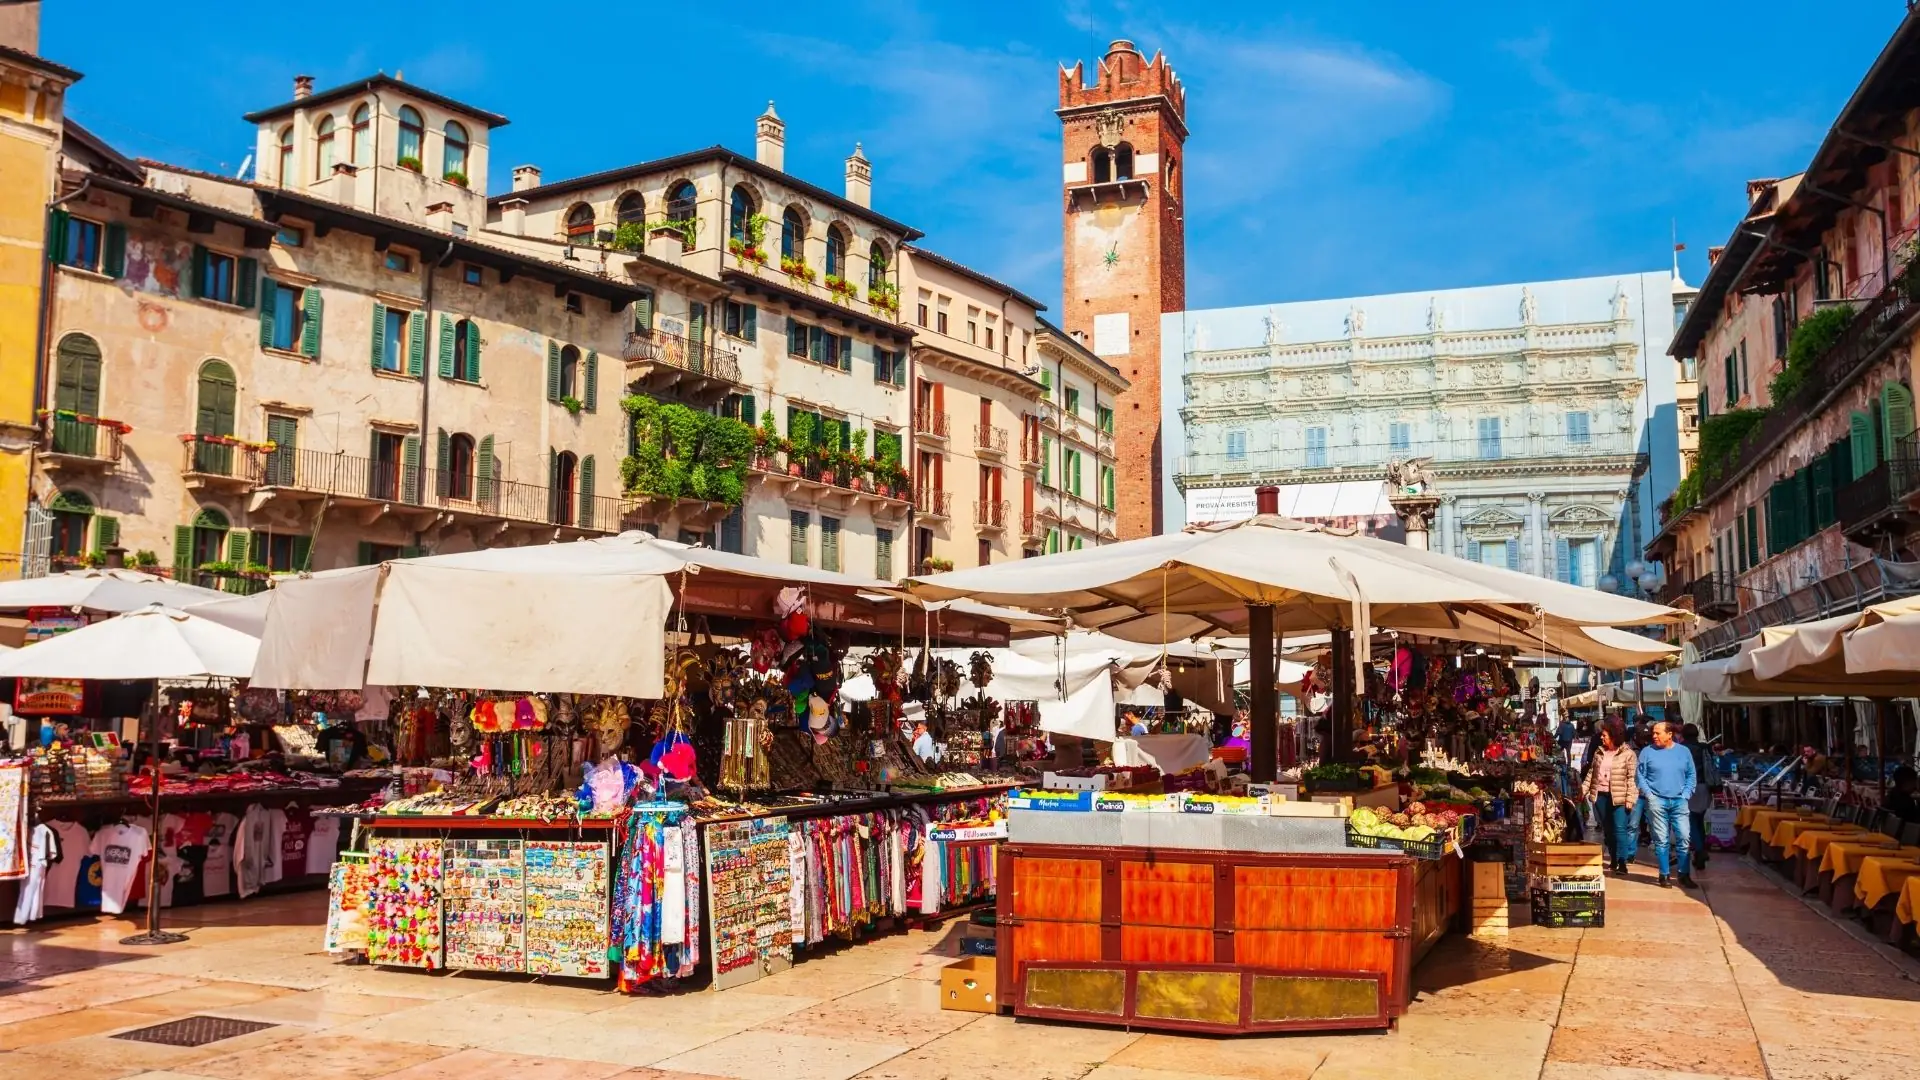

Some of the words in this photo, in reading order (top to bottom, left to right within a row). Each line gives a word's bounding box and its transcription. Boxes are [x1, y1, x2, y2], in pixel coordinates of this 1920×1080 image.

[1097, 802, 1124, 811] Melinda
[1185, 803, 1213, 812] Melinda
[930, 831, 955, 840] Melinda
